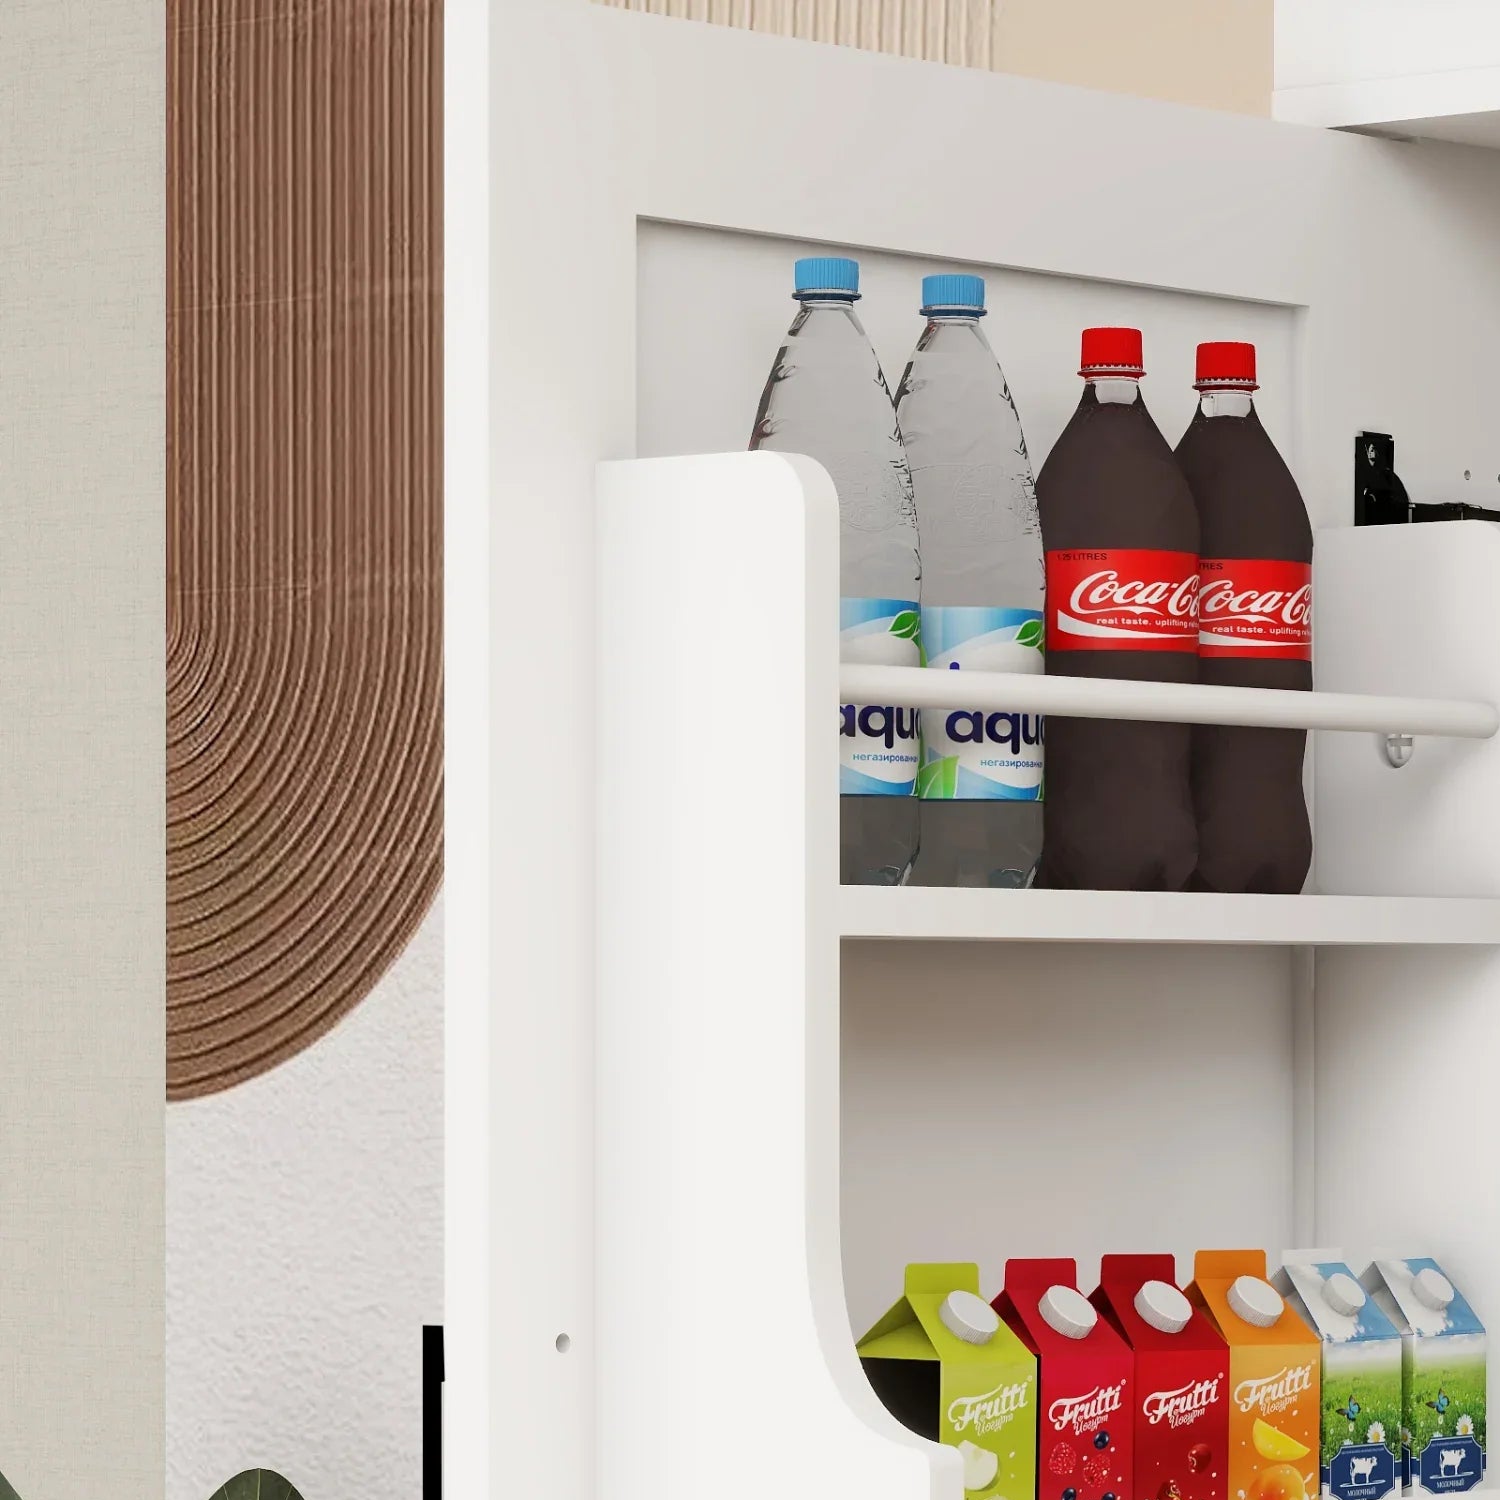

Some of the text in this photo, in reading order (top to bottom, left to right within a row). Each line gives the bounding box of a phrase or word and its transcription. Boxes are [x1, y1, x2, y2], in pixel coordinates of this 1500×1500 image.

[1073, 552, 1108, 561] LITRES
[1096, 617, 1118, 626] real
[1155, 617, 1188, 629] uplifting
[948, 1382, 1028, 1431] Frutti
[1048, 1384, 1122, 1431] Frutti
[1143, 1378, 1219, 1425] Frutti
[1234, 1364, 1312, 1412] Frutti
